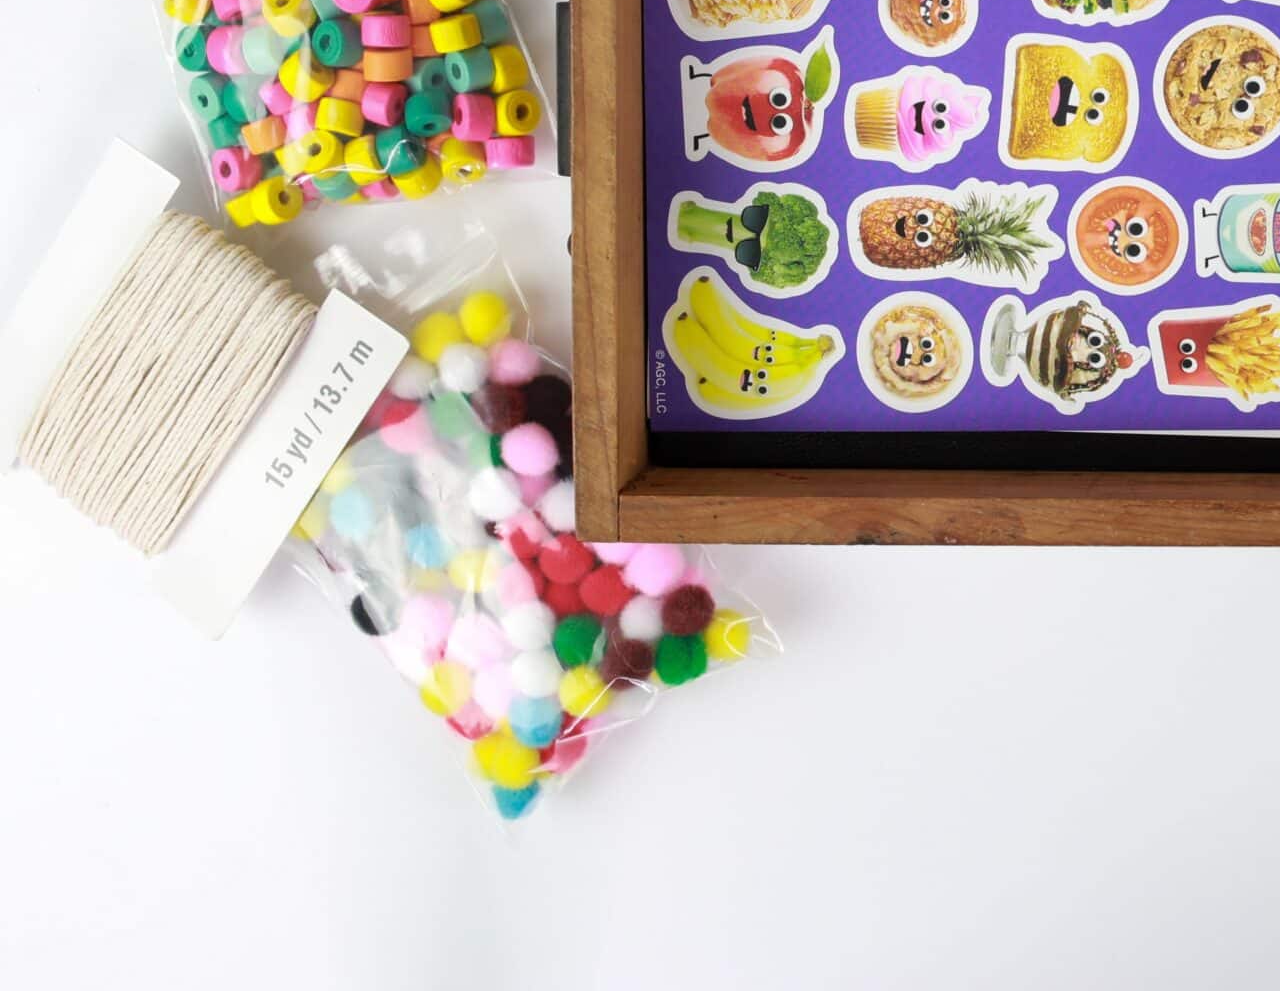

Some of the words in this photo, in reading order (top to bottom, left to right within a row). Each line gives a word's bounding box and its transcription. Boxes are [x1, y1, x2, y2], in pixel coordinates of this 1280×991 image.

[349, 339, 374, 365] m
[313, 362, 354, 415] 13.7
[656, 392, 667, 414] LLC
[304, 411, 323, 435] /
[286, 427, 313, 464] yd
[264, 457, 294, 488] 15
